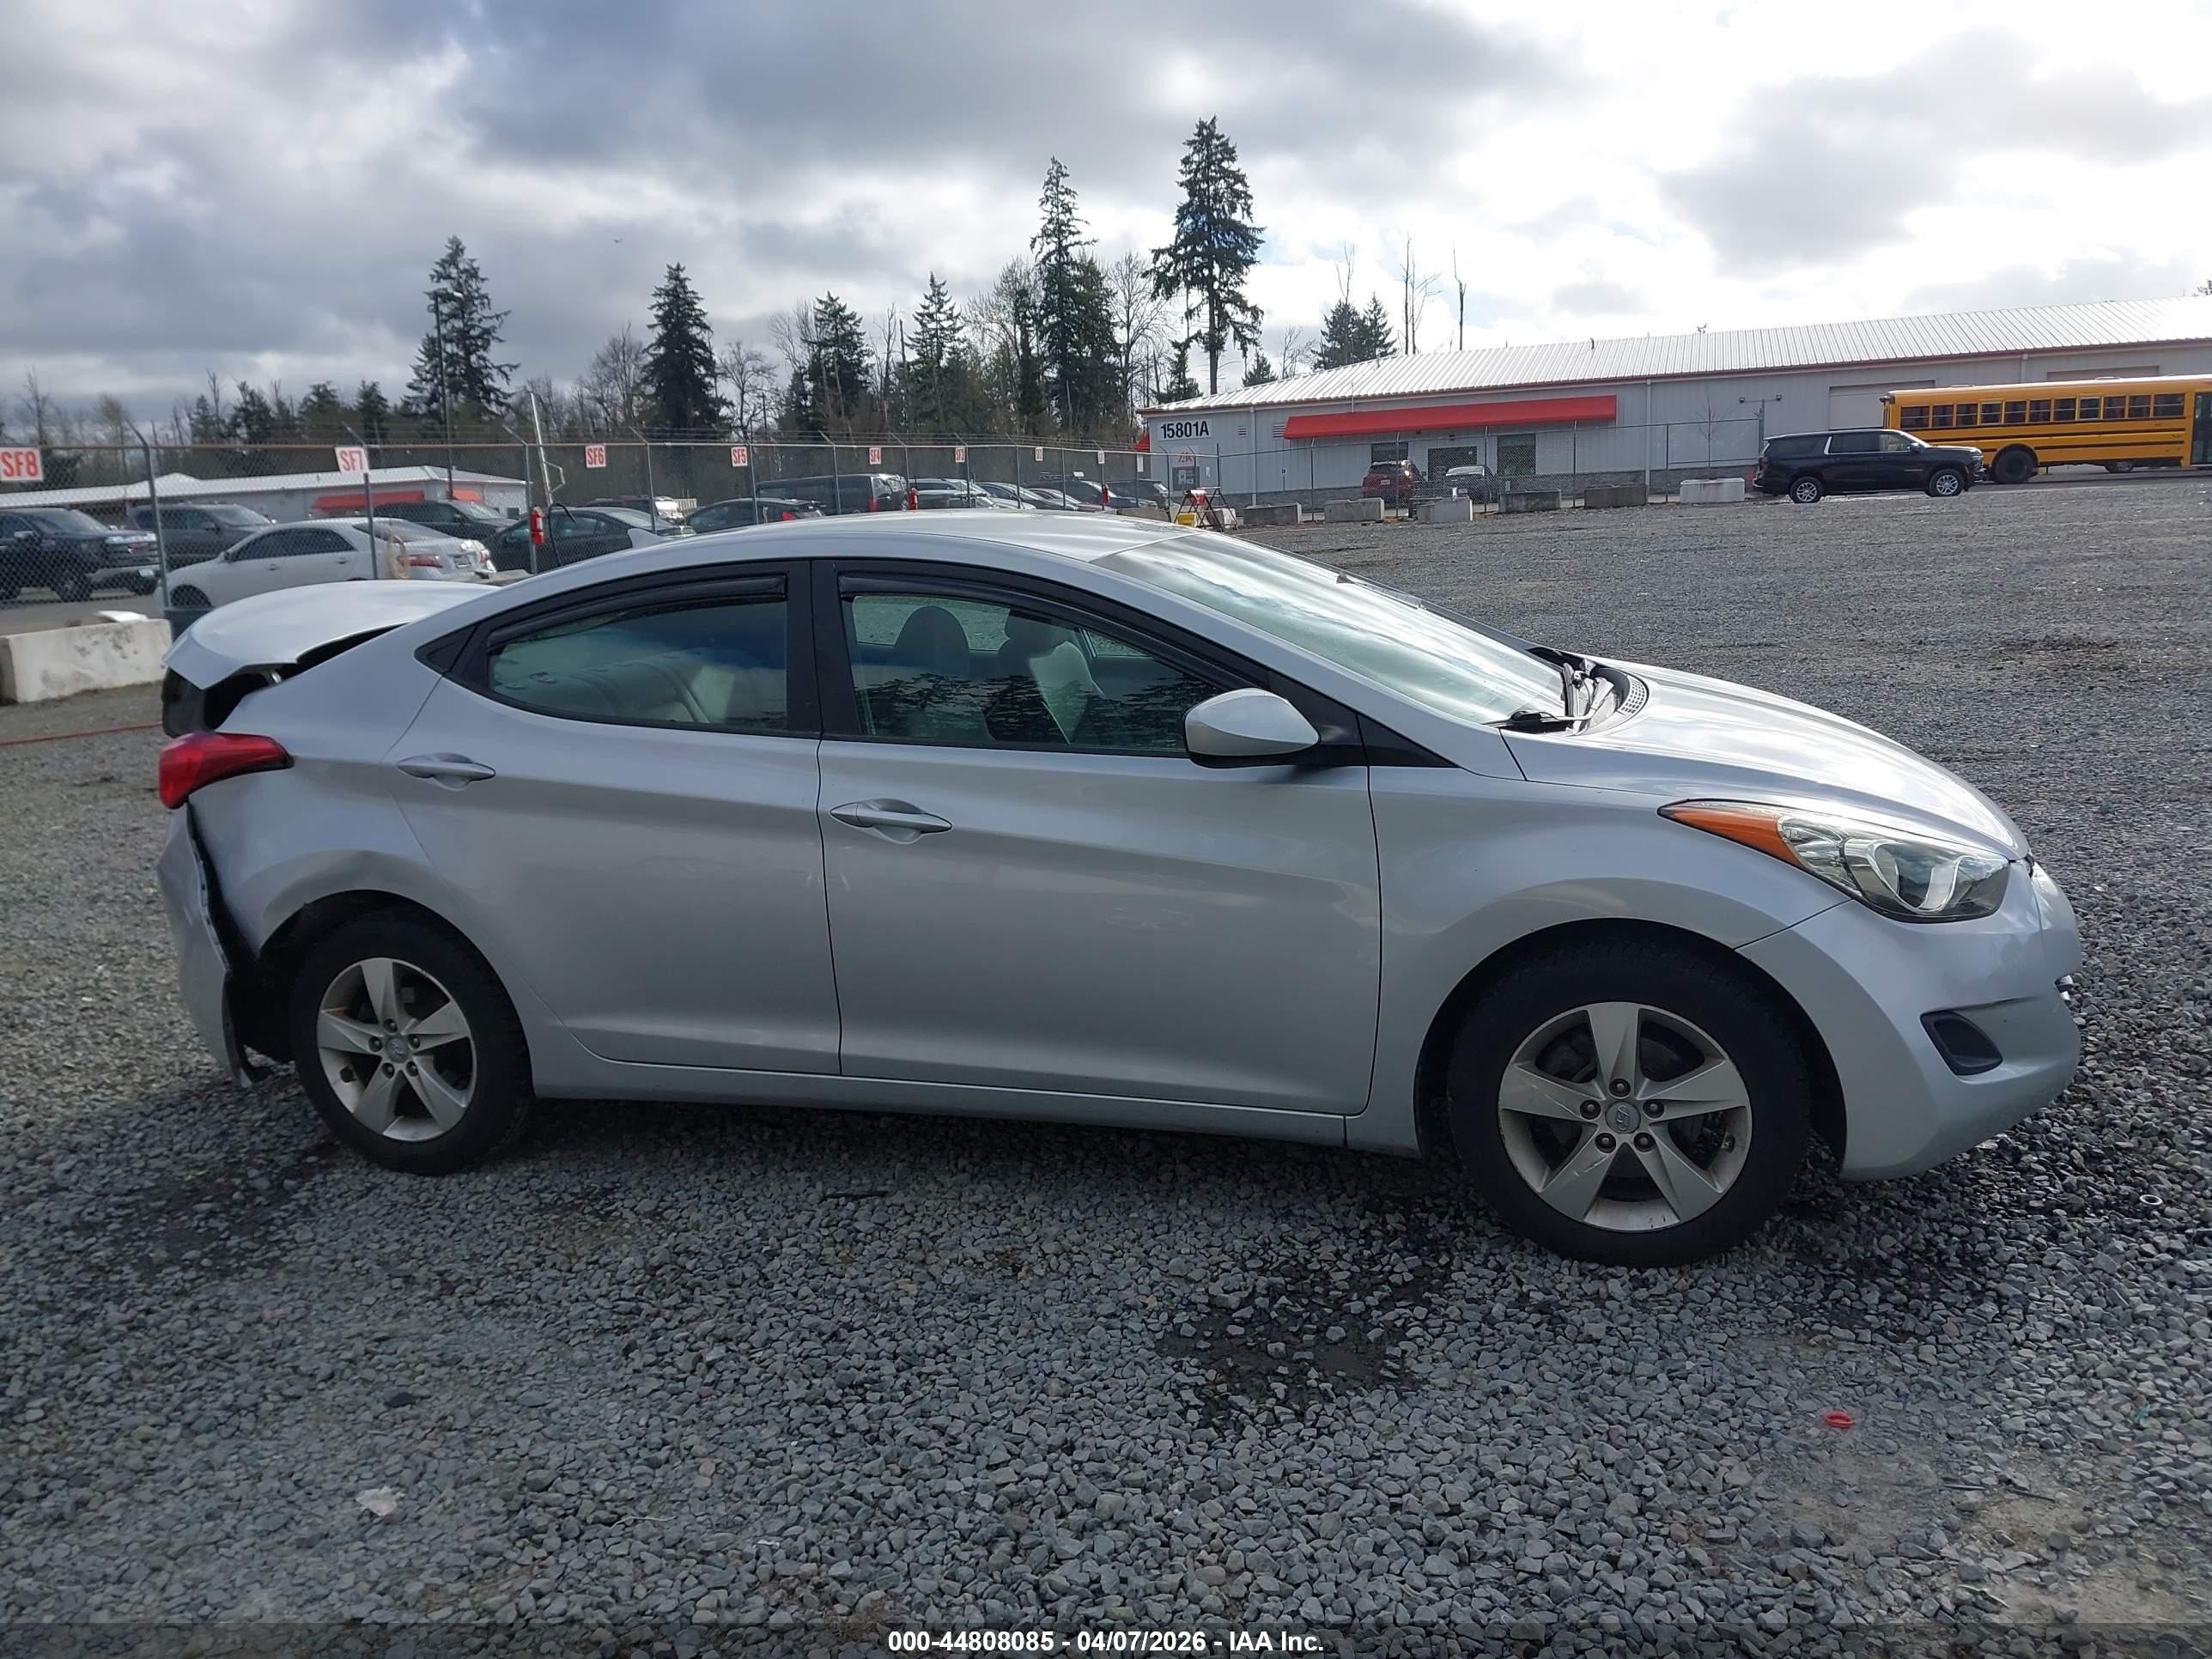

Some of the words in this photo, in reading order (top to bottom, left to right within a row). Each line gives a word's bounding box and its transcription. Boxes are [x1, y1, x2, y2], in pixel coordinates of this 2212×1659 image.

[1160, 421, 1209, 439] 15801A
[1, 451, 39, 477] SF8
[339, 450, 363, 471] SF7
[587, 447, 605, 465] SF6
[732, 449, 746, 465] SF5
[870, 448, 880, 464] SF4
